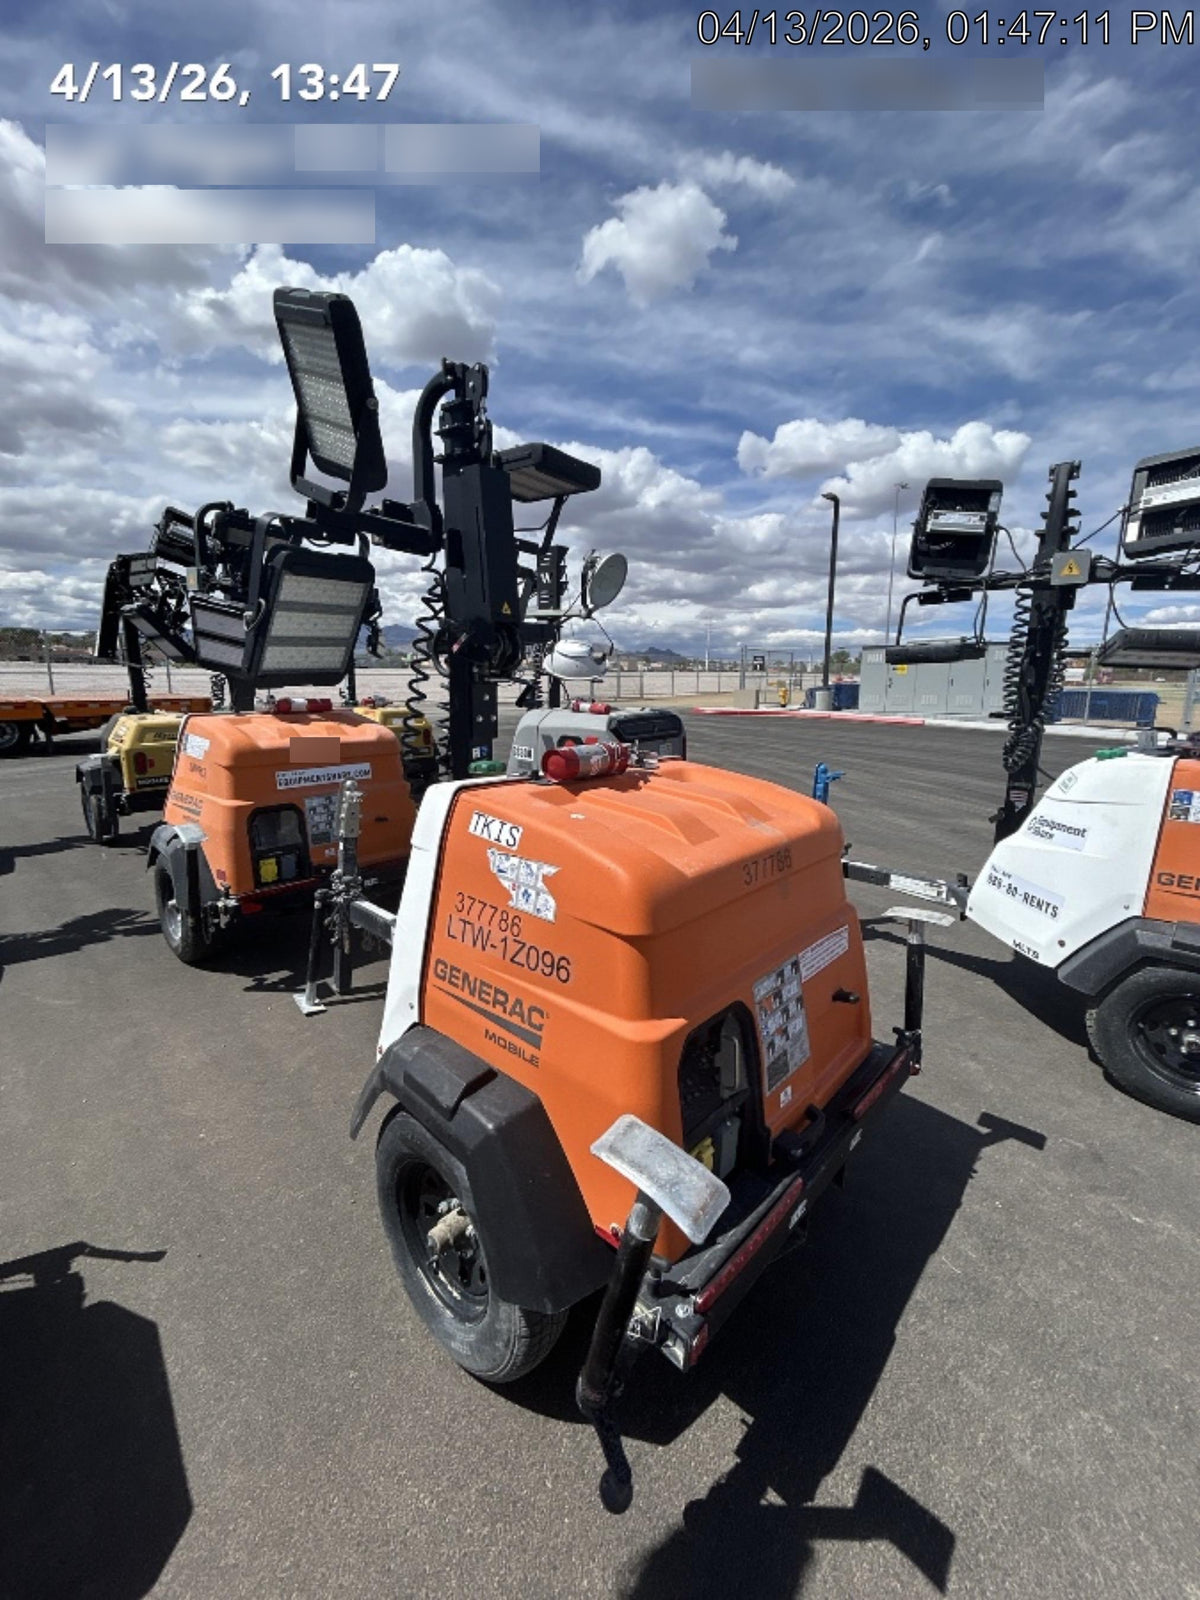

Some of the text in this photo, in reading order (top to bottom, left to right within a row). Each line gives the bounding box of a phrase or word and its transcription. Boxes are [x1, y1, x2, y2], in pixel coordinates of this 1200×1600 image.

[473, 811, 520, 848] TKIS
[743, 849, 793, 886] 377786
[455, 892, 521, 938] 377786
[447, 913, 572, 984] LTW-1Z096
[434, 958, 545, 1031] GENERAC
[484, 1029, 540, 1068] MOBILE
